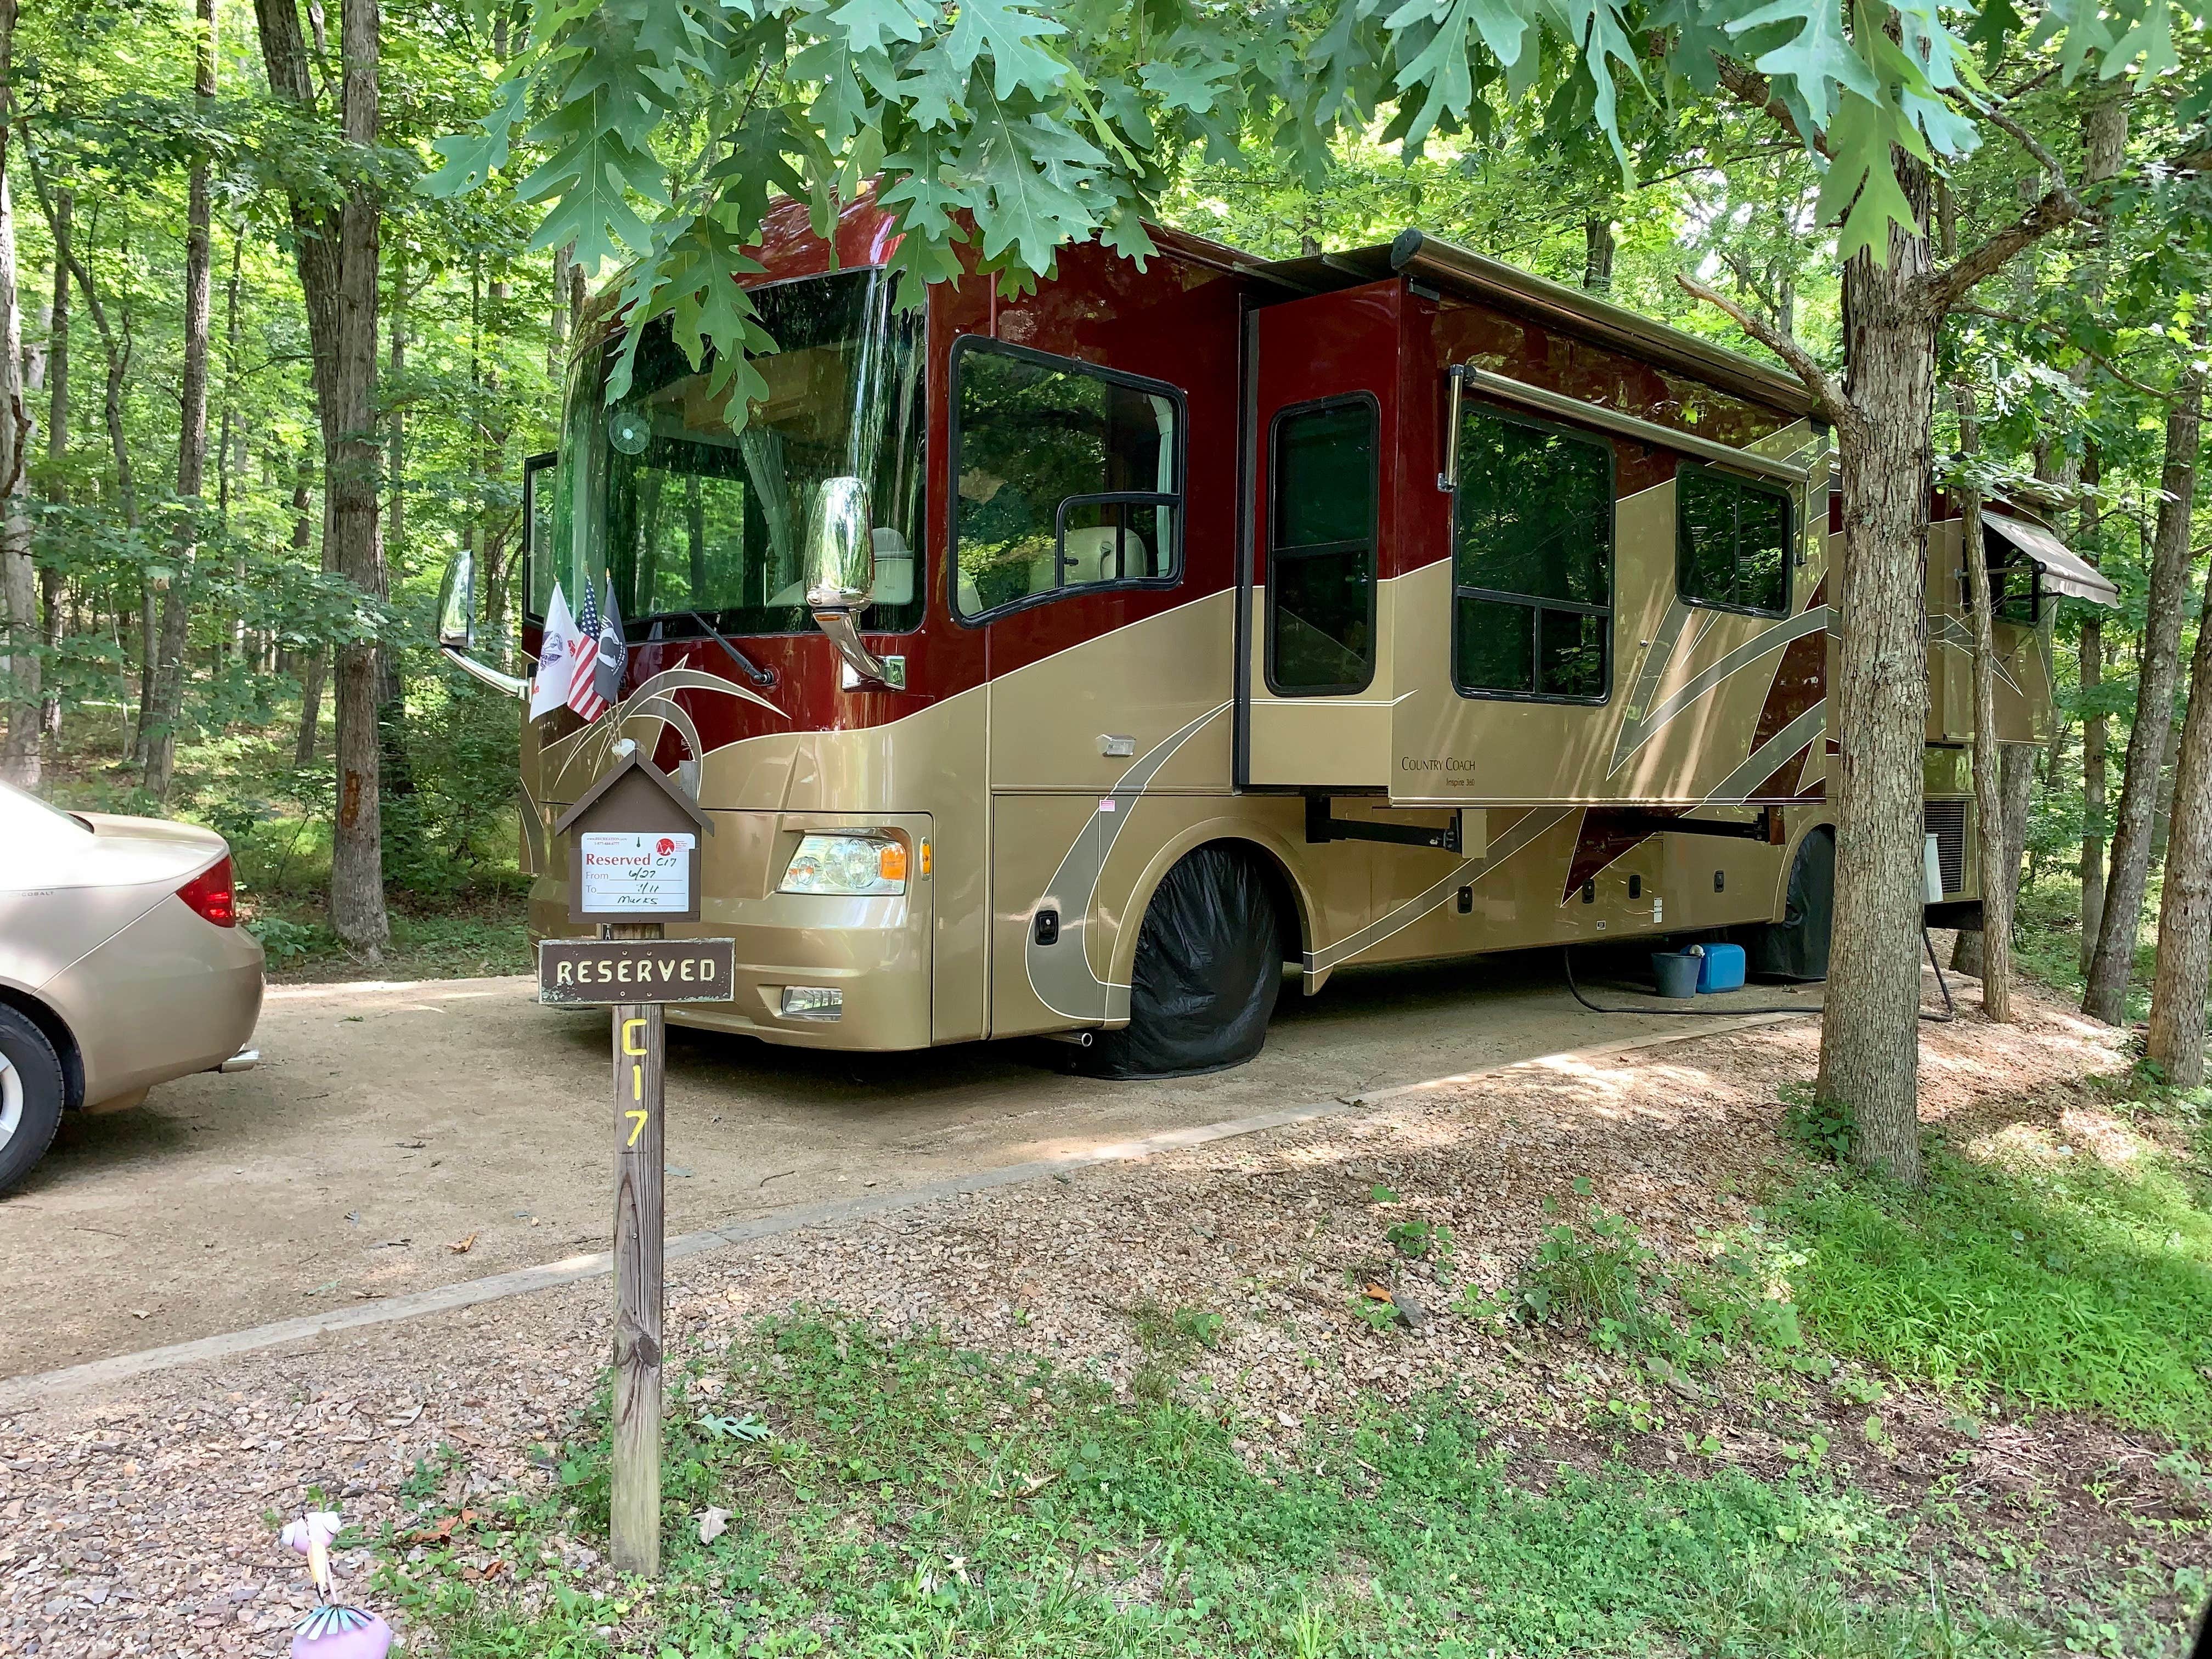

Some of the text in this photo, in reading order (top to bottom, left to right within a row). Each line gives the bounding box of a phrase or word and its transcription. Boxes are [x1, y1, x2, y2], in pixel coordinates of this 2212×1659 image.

[1402, 757, 1475, 771] COUNTRY COACH
[1446, 778, 1464, 787] Inspire
[586, 853, 651, 865] Reserved
[656, 857, 676, 867] C17
[629, 867, 656, 881] 6/27
[586, 885, 597, 893] To
[557, 959, 715, 983] RESERVED
[623, 1019, 648, 1147] C17
